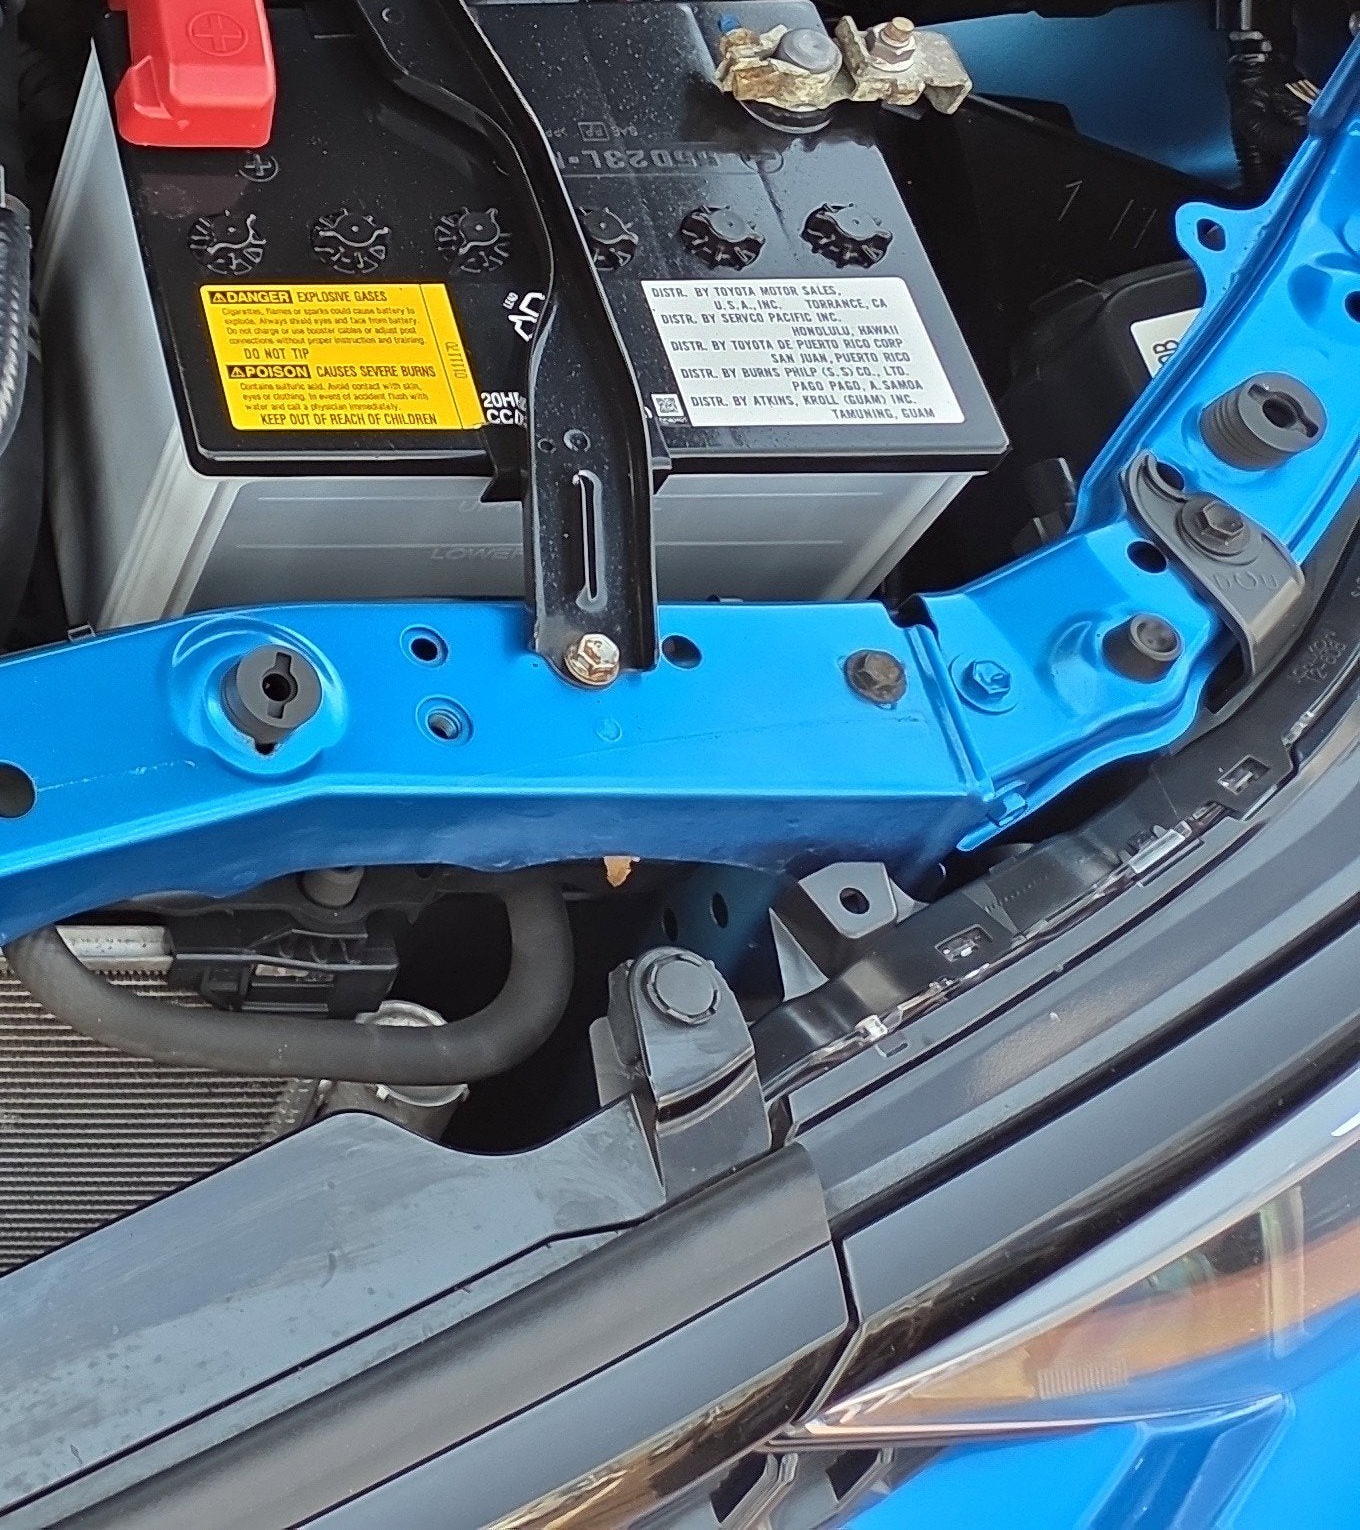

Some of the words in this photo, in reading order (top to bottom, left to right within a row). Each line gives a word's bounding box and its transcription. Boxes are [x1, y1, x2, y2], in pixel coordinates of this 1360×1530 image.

[226, 291, 290, 303] DANGER
[296, 291, 351, 302] EXPLOSIVE
[354, 290, 387, 301] GASES
[652, 287, 688, 298] DISTR.
[694, 286, 709, 297] BY
[713, 286, 756, 297] TOYOTA
[759, 286, 798, 297] MOTOR
[802, 286, 842, 297] SALES,
[806, 298, 870, 310] TORRANCE,
[872, 298, 888, 309] CA
[661, 313, 698, 324] DISTR.
[701, 313, 716, 324] BY
[721, 313, 764, 324] SERVCO
[768, 313, 813, 324] PACIFIC
[817, 313, 842, 324] INC.
[792, 325, 854, 337] HONOLULU,
[858, 325, 900, 337] HAWAII
[670, 340, 708, 351] DISTR.
[711, 340, 726, 351] BY
[730, 339, 773, 350] TOYOTA
[778, 339, 793, 350] DE
[796, 339, 839, 350] PUERTO
[844, 339, 871, 350] RICO
[874, 339, 903, 350] CORP
[244, 348, 260, 360] DO
[264, 348, 286, 360] NOT
[290, 348, 309, 360] TIP
[771, 353, 795, 364] SAN
[800, 353, 833, 365] JUAN,
[835, 352, 879, 363] PUERTO
[883, 352, 910, 362] RICO
[246, 366, 309, 377] POISON
[316, 366, 357, 377] CAUSES
[359, 366, 398, 377] SEVERE
[400, 366, 436, 377] BURNS
[681, 368, 718, 379] DISTR.
[722, 368, 737, 378] BY
[742, 366, 781, 378] BURNS
[785, 366, 817, 378] PHILP
[886, 366, 909, 378] LTD.
[792, 380, 824, 391] PAGO
[830, 380, 866, 392] PAGO,
[884, 379, 923, 390] SAMOA
[691, 396, 728, 407] DISTR.
[732, 396, 747, 406] BY
[753, 395, 799, 407] ATKINS,
[803, 395, 839, 405] KROLL
[843, 394, 887, 405] (GUAM)
[891, 394, 917, 405] INC.
[260, 413, 286, 425] KEEP
[290, 413, 311, 425] OUT
[314, 413, 327, 425] OF
[330, 413, 365, 425] REACH
[368, 413, 381, 425] OF
[384, 413, 437, 425] CHILDREN
[831, 408, 898, 420] TAMUNING,
[902, 408, 935, 418] GUAM
